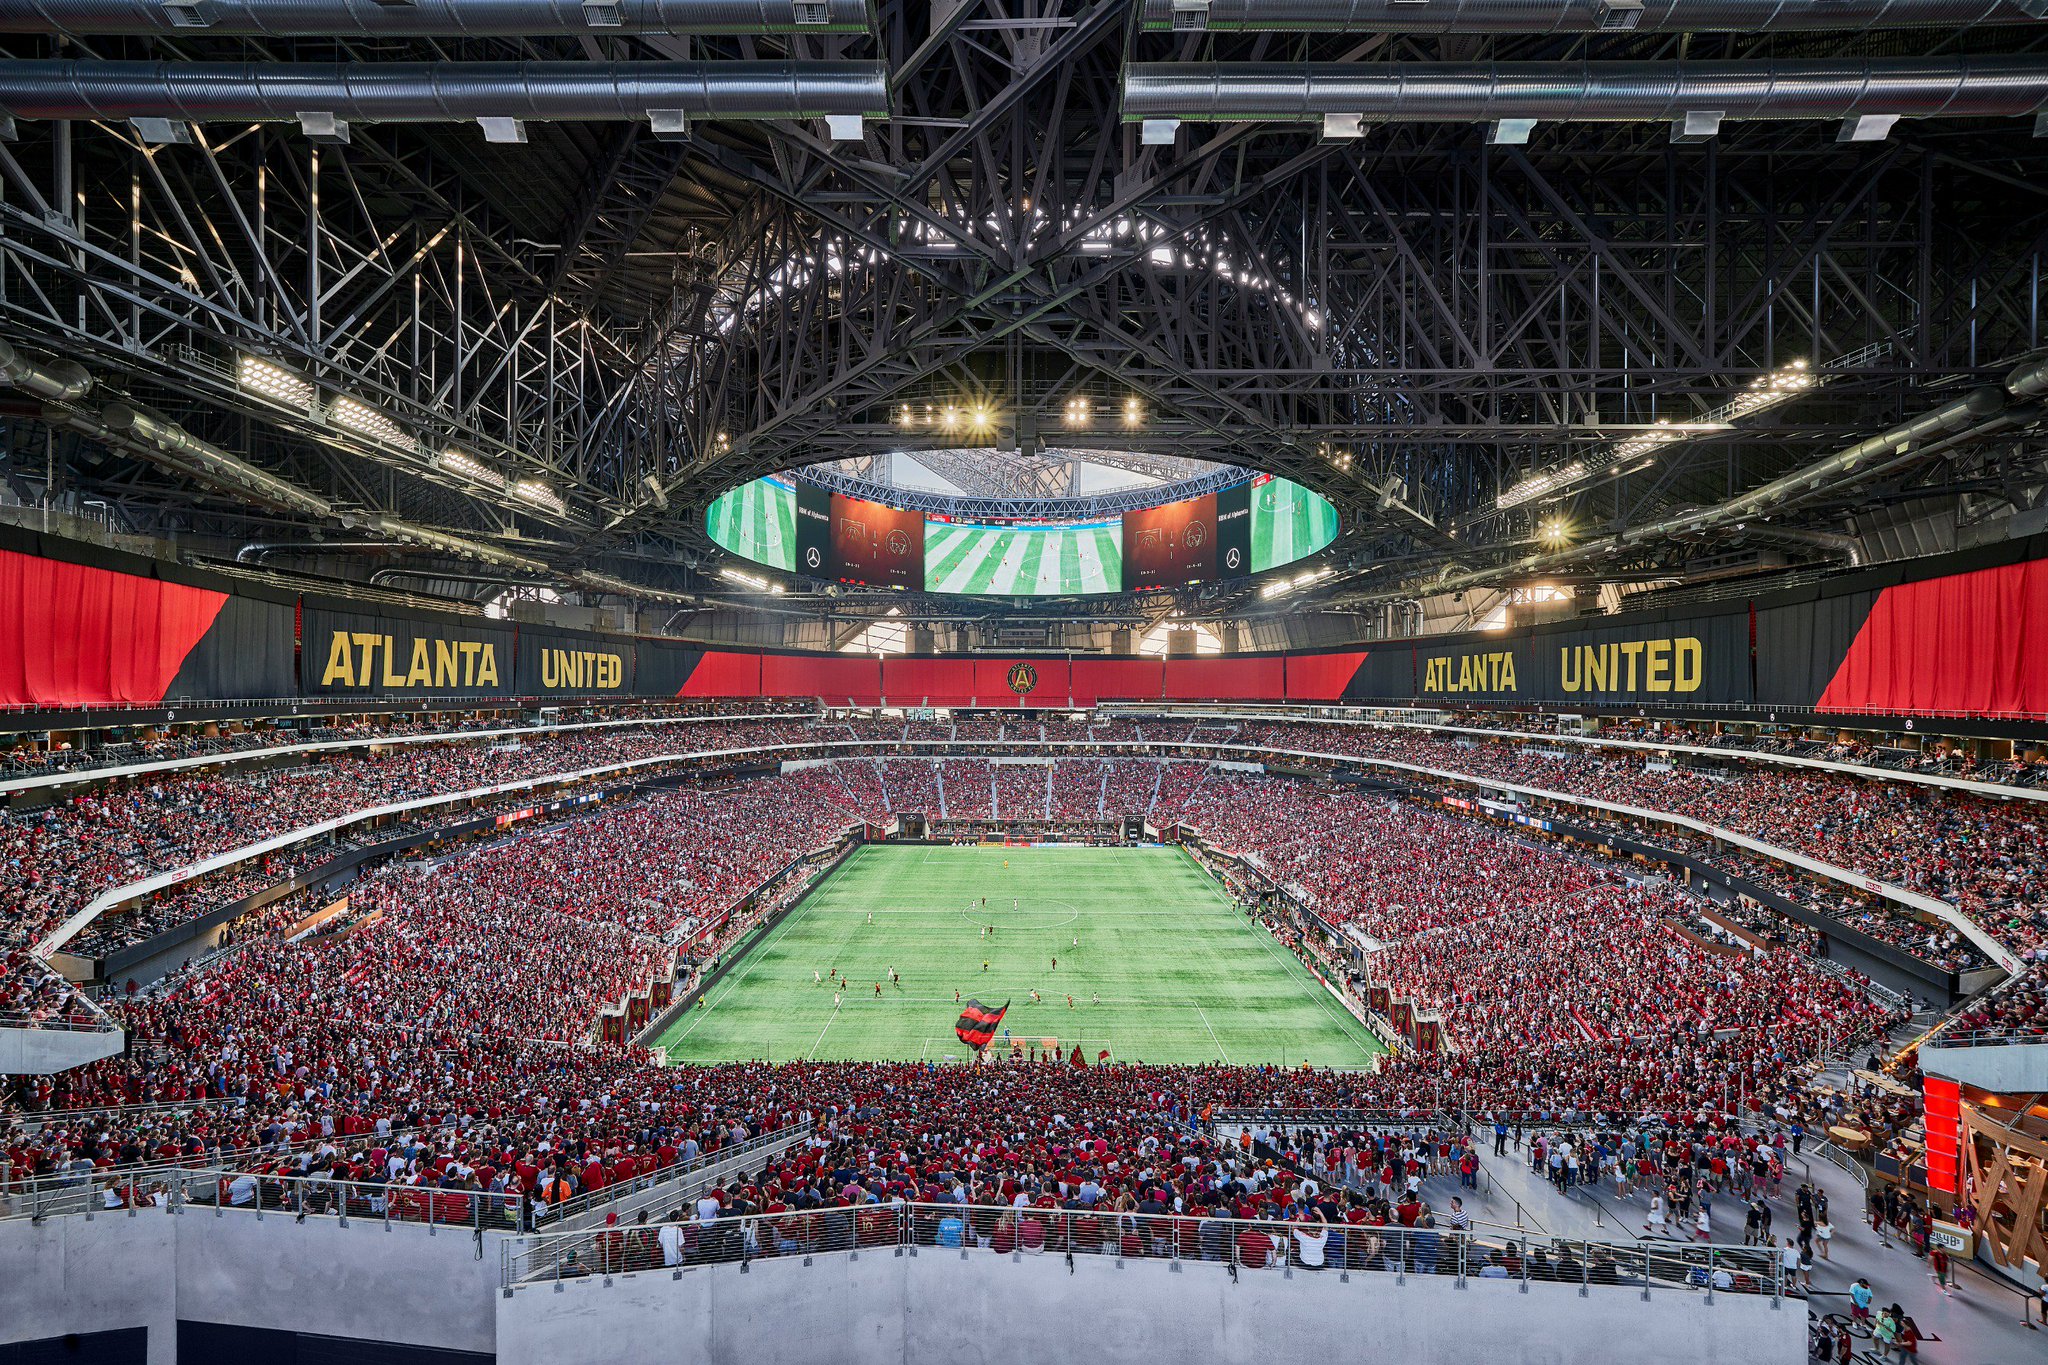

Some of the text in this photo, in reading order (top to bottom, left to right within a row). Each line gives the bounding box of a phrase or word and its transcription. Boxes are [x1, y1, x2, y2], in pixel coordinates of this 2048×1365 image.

[321, 631, 498, 688] ATLANTA
[541, 649, 622, 689] UNITED
[1015, 669, 1029, 687] A
[1423, 651, 1517, 692] ATLANTA
[1561, 638, 1702, 692] UNITED
